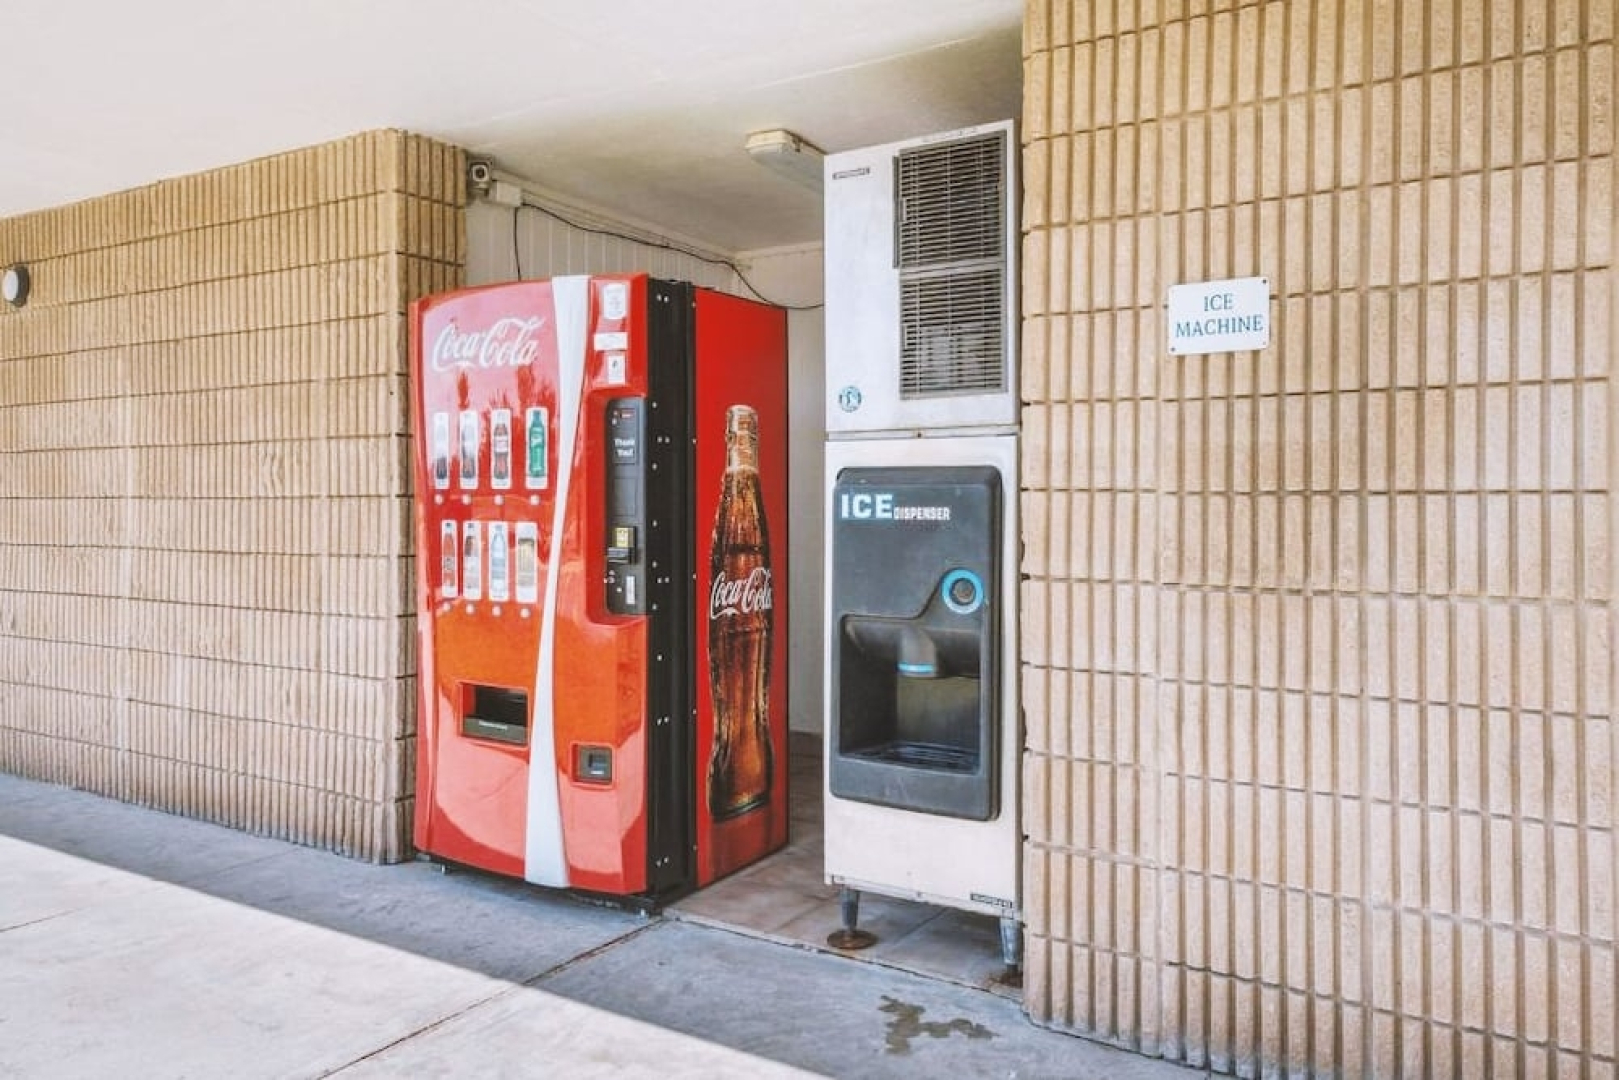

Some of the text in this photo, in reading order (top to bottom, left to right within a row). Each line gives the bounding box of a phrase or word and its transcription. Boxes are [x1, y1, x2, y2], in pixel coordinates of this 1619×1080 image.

[1203, 293, 1233, 312] ICE
[1175, 314, 1263, 337] MACHINE
[432, 316, 545, 371] Coca-Cola
[841, 493, 951, 520] ICE DISPENSER
